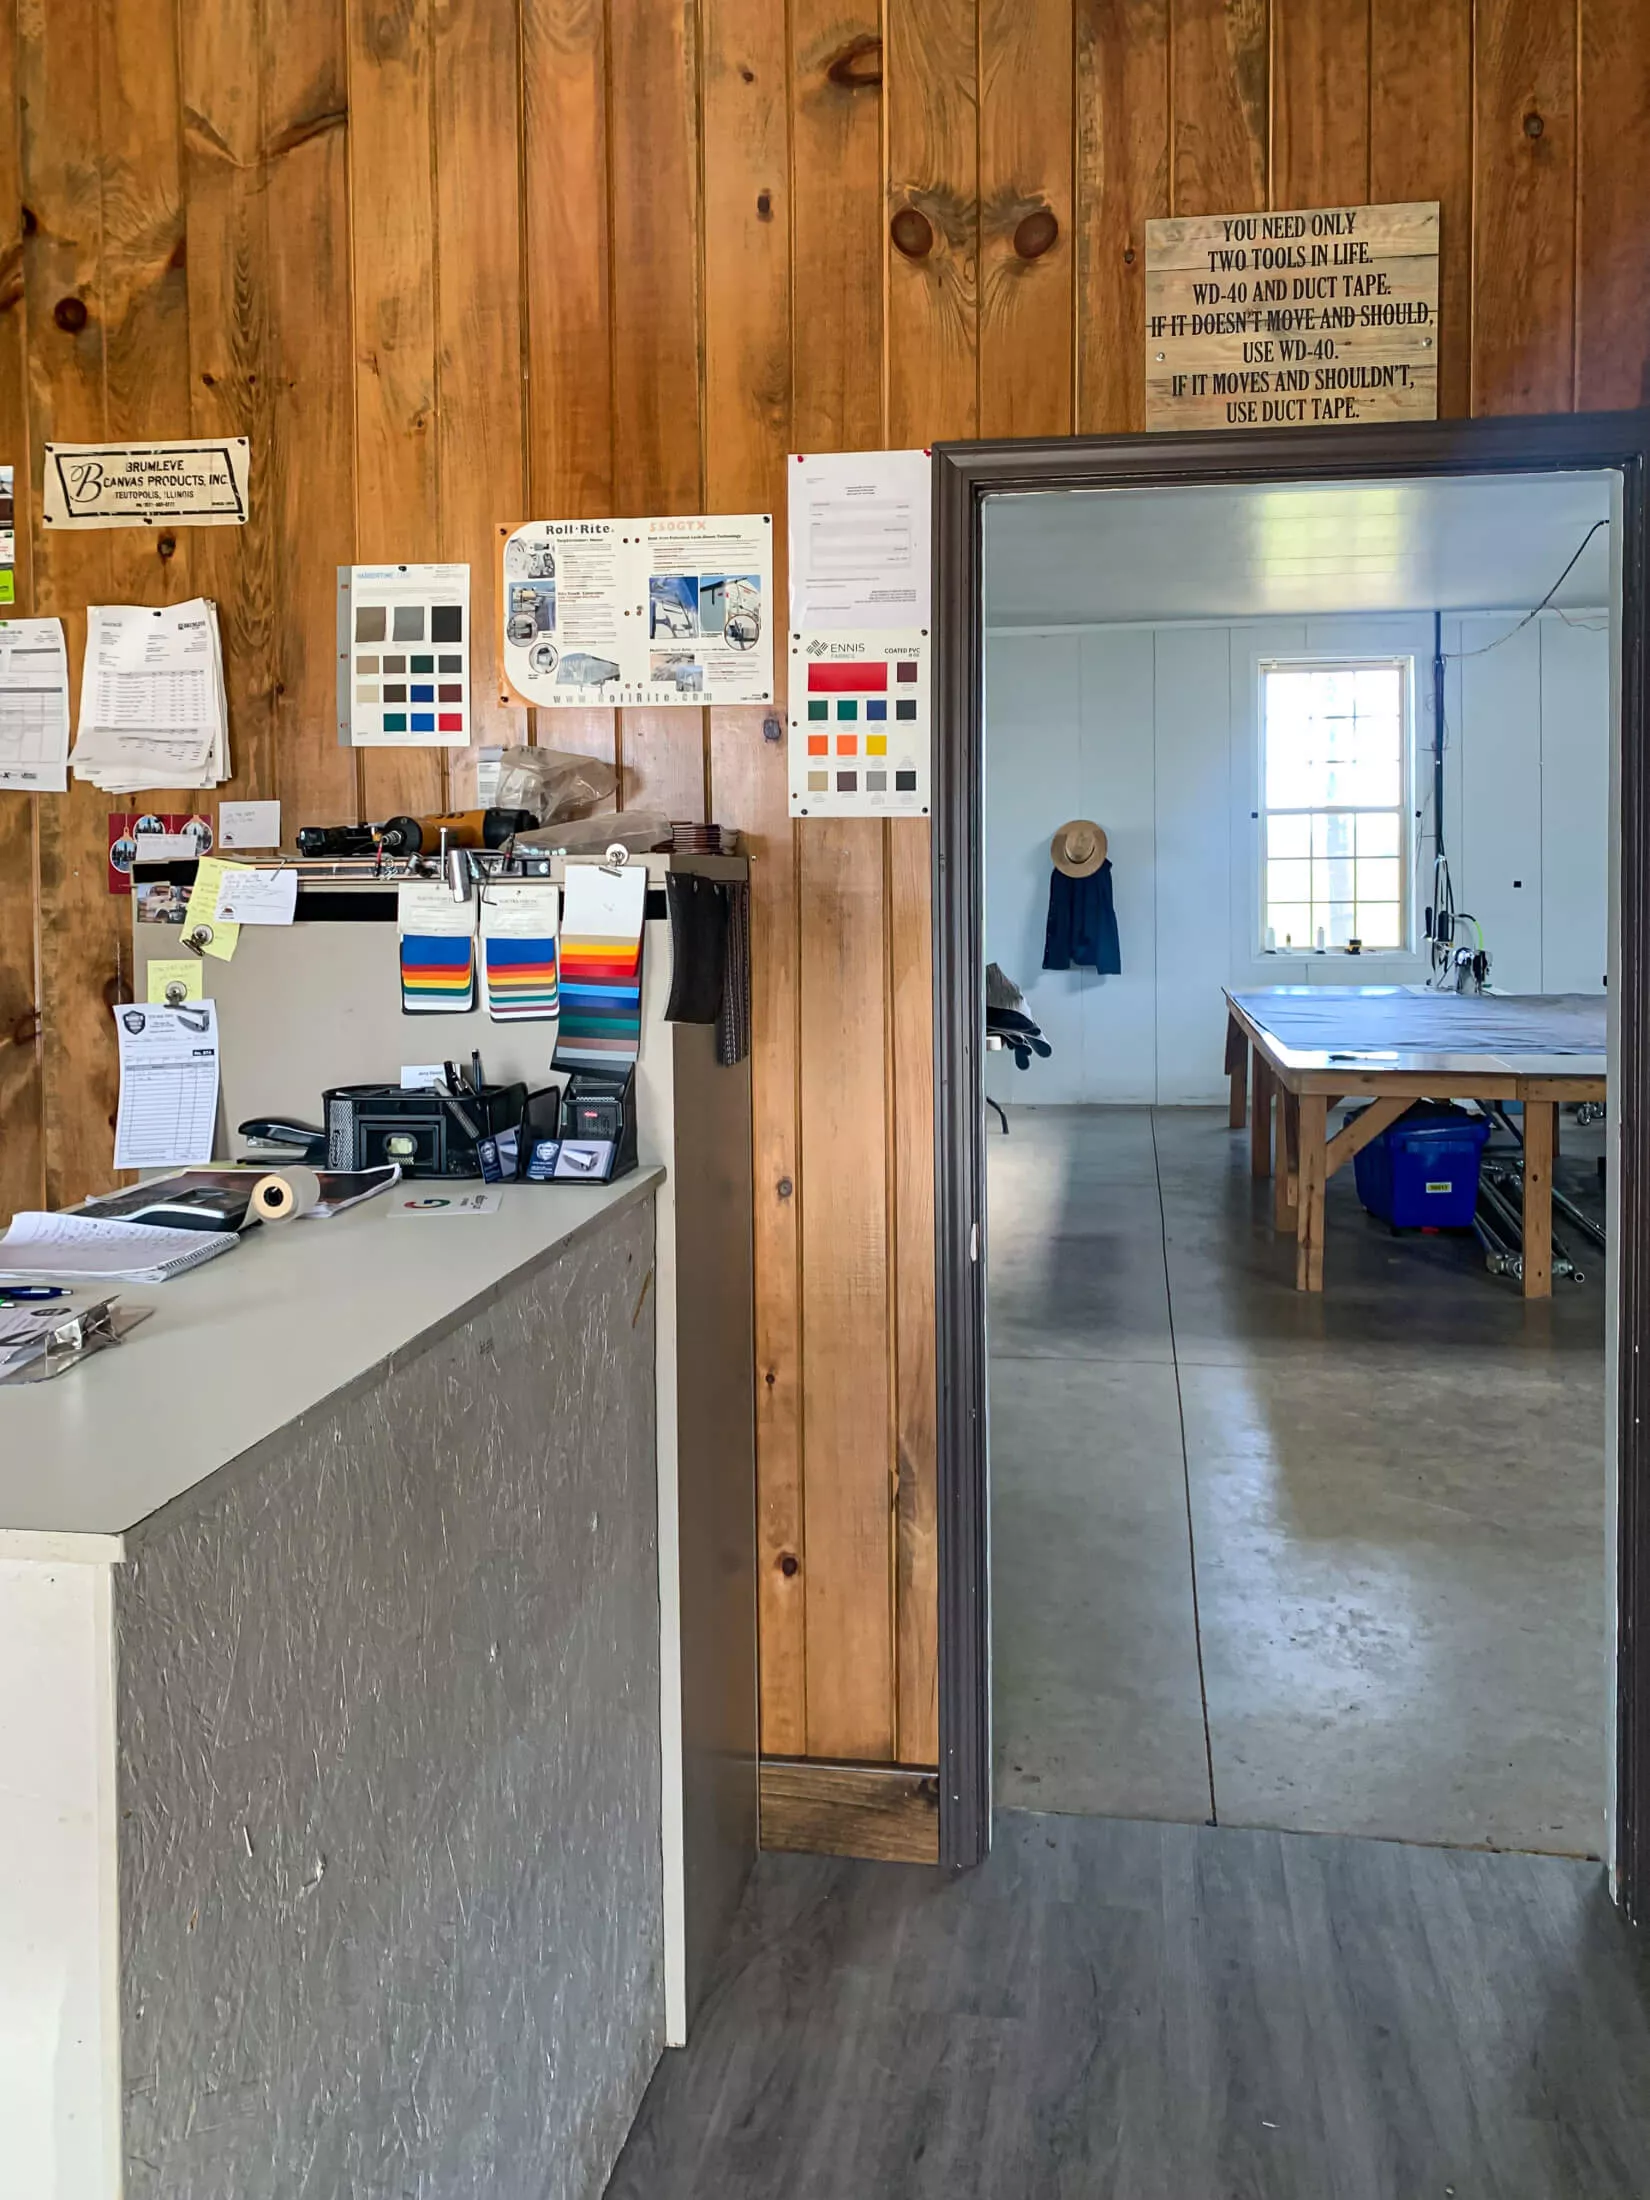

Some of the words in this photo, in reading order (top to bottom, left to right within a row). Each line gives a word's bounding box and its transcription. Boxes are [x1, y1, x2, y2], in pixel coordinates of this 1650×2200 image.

[1223, 218, 1257, 242] YOU
[1262, 216, 1306, 239] NEED
[1311, 212, 1357, 237] ONLY
[1208, 250, 1247, 273] TWO
[1251, 247, 1306, 270] TOOLS
[1311, 244, 1328, 267] IN
[1333, 242, 1374, 266] LIFE.
[1193, 282, 1247, 305] WD-40
[1253, 279, 1287, 302] AND
[1293, 276, 1338, 300] DUCT
[1343, 273, 1391, 298] TAPE.
[1151, 316, 1166, 337] IF
[1171, 314, 1187, 336] IT
[1192, 310, 1262, 335] DOESN'T
[1267, 308, 1315, 332] MOVE
[1320, 306, 1356, 329] AND
[1360, 302, 1434, 327] SHOULD,
[1243, 341, 1274, 364] USE
[1279, 338, 1339, 362] WD-40.
[1172, 375, 1187, 397] IF
[1192, 374, 1208, 396] IT
[1212, 371, 1270, 395] MOVES
[1274, 368, 1310, 392] AND
[1314, 364, 1415, 391] SHOULDN'T,
[1226, 401, 1258, 423] USE
[1262, 399, 1307, 422] DUCT
[1311, 396, 1360, 420] TAPE.
[126, 460, 184, 473] BRUMLEVE
[104, 476, 144, 488] CANVAS
[148, 474, 207, 488] PRODUCTS,
[830, 642, 865, 653] ENNIS
